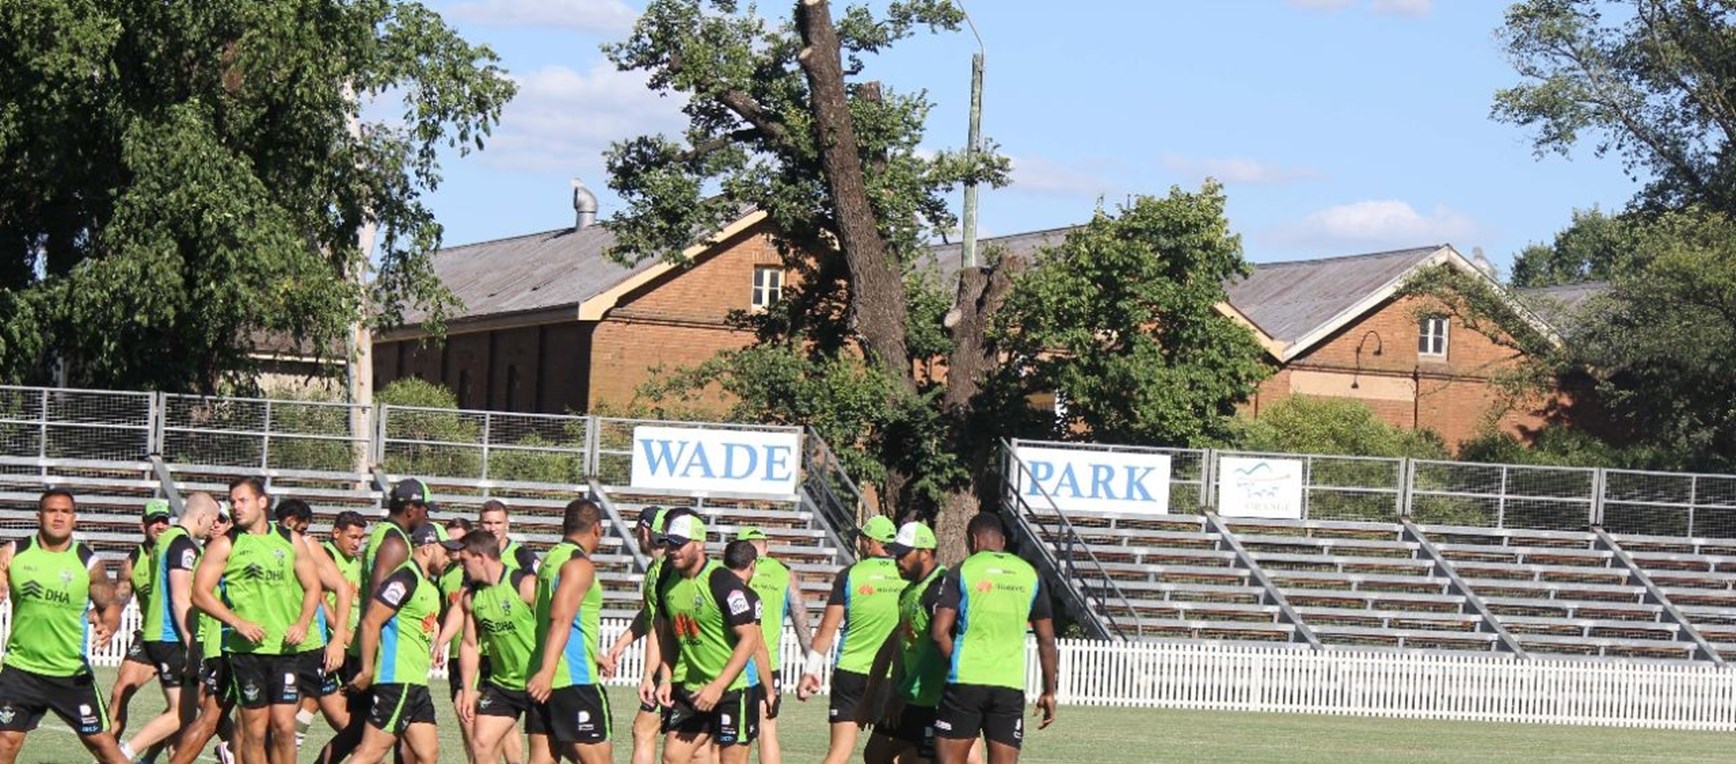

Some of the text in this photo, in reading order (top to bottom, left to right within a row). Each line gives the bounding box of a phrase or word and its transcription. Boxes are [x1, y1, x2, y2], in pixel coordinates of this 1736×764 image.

[638, 438, 792, 482] WADE
[1025, 460, 1157, 502] PARK
[45, 588, 71, 604] DHA
[495, 621, 516, 633] DHA
